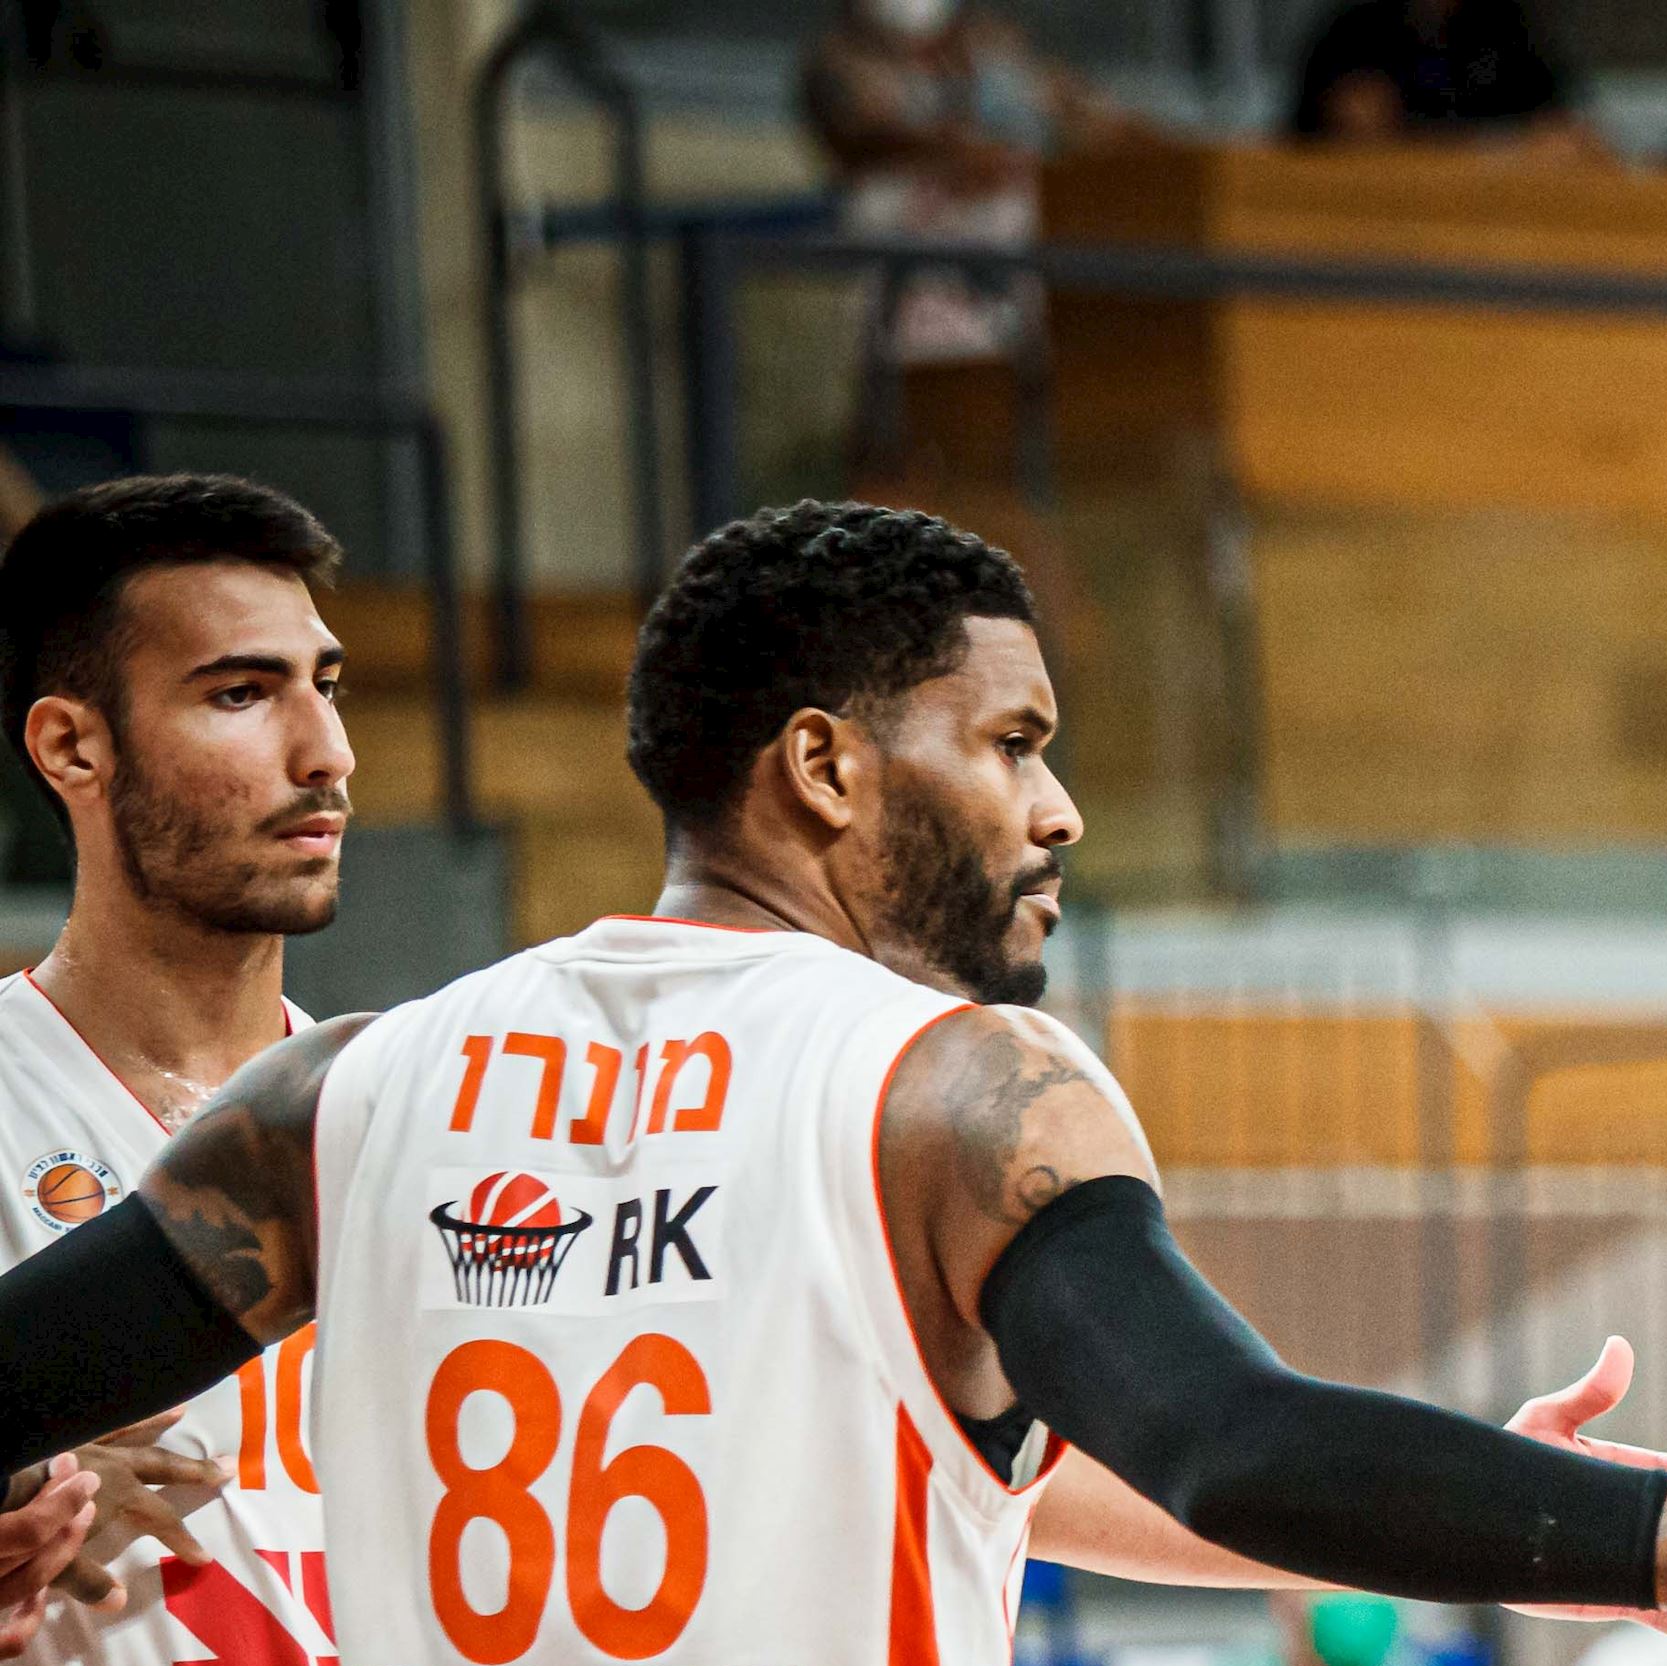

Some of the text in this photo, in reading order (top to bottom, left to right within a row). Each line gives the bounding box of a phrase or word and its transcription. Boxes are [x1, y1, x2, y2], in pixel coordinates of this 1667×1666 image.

[448, 1030, 733, 1146] מונרו
[604, 1185, 719, 1296] RK
[425, 1332, 713, 1665] 86
